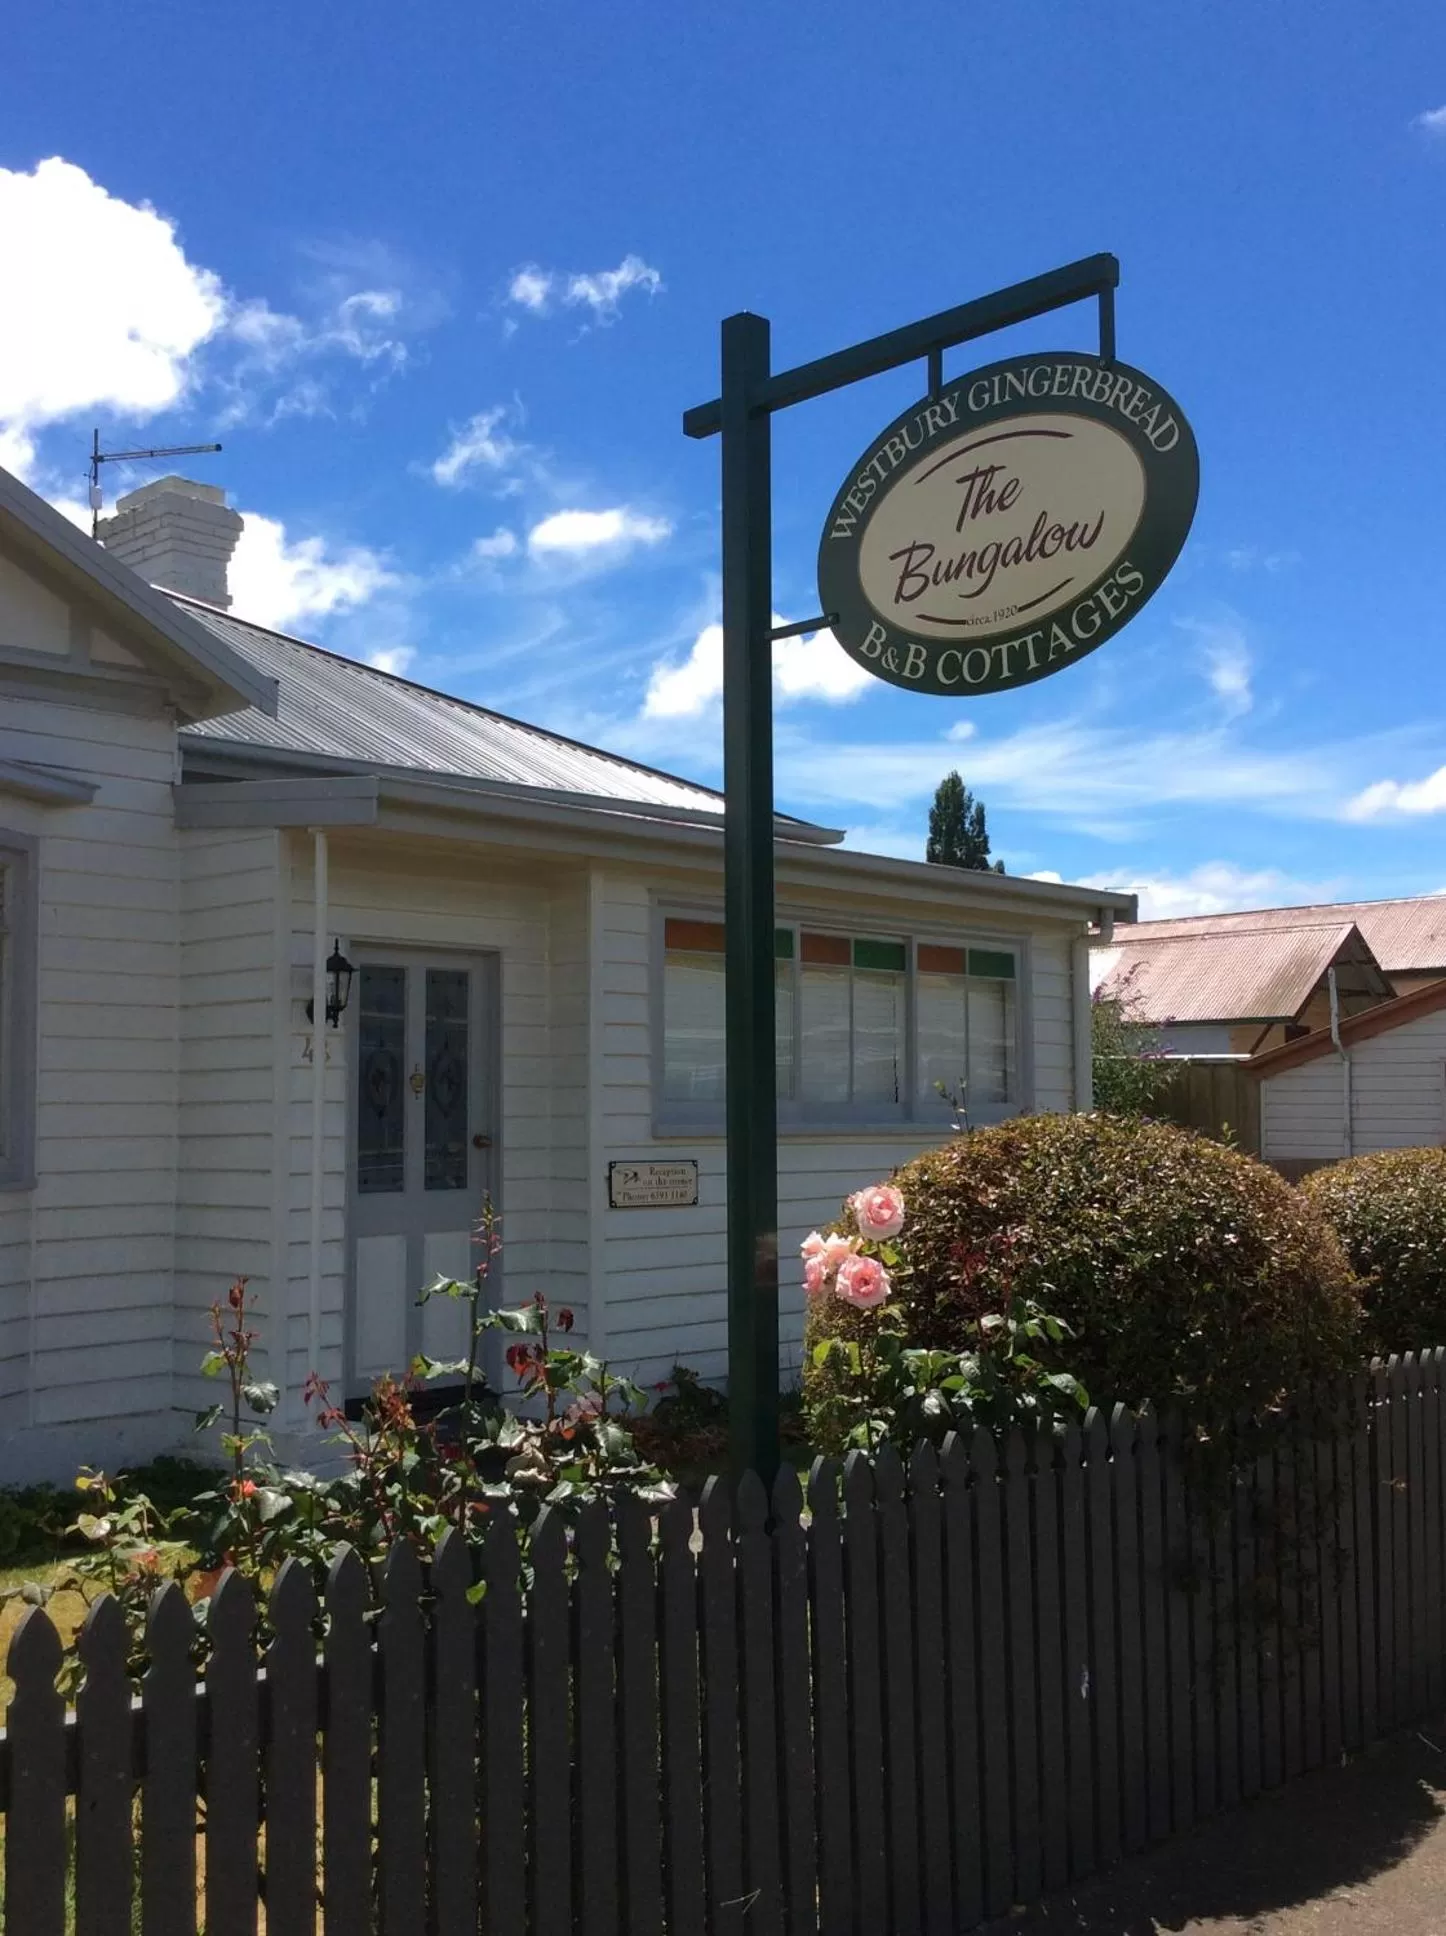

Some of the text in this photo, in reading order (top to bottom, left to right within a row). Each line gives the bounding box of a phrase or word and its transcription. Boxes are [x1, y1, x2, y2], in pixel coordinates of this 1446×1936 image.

[830, 364, 1180, 539] WESTBURY GINGERBREAD
[955, 464, 1024, 532] The
[889, 510, 1104, 604] Bungalow
[859, 560, 1144, 685] B&B COTTAGES
[993, 604, 1018, 623] 1920
[649, 1166, 687, 1177] Reception
